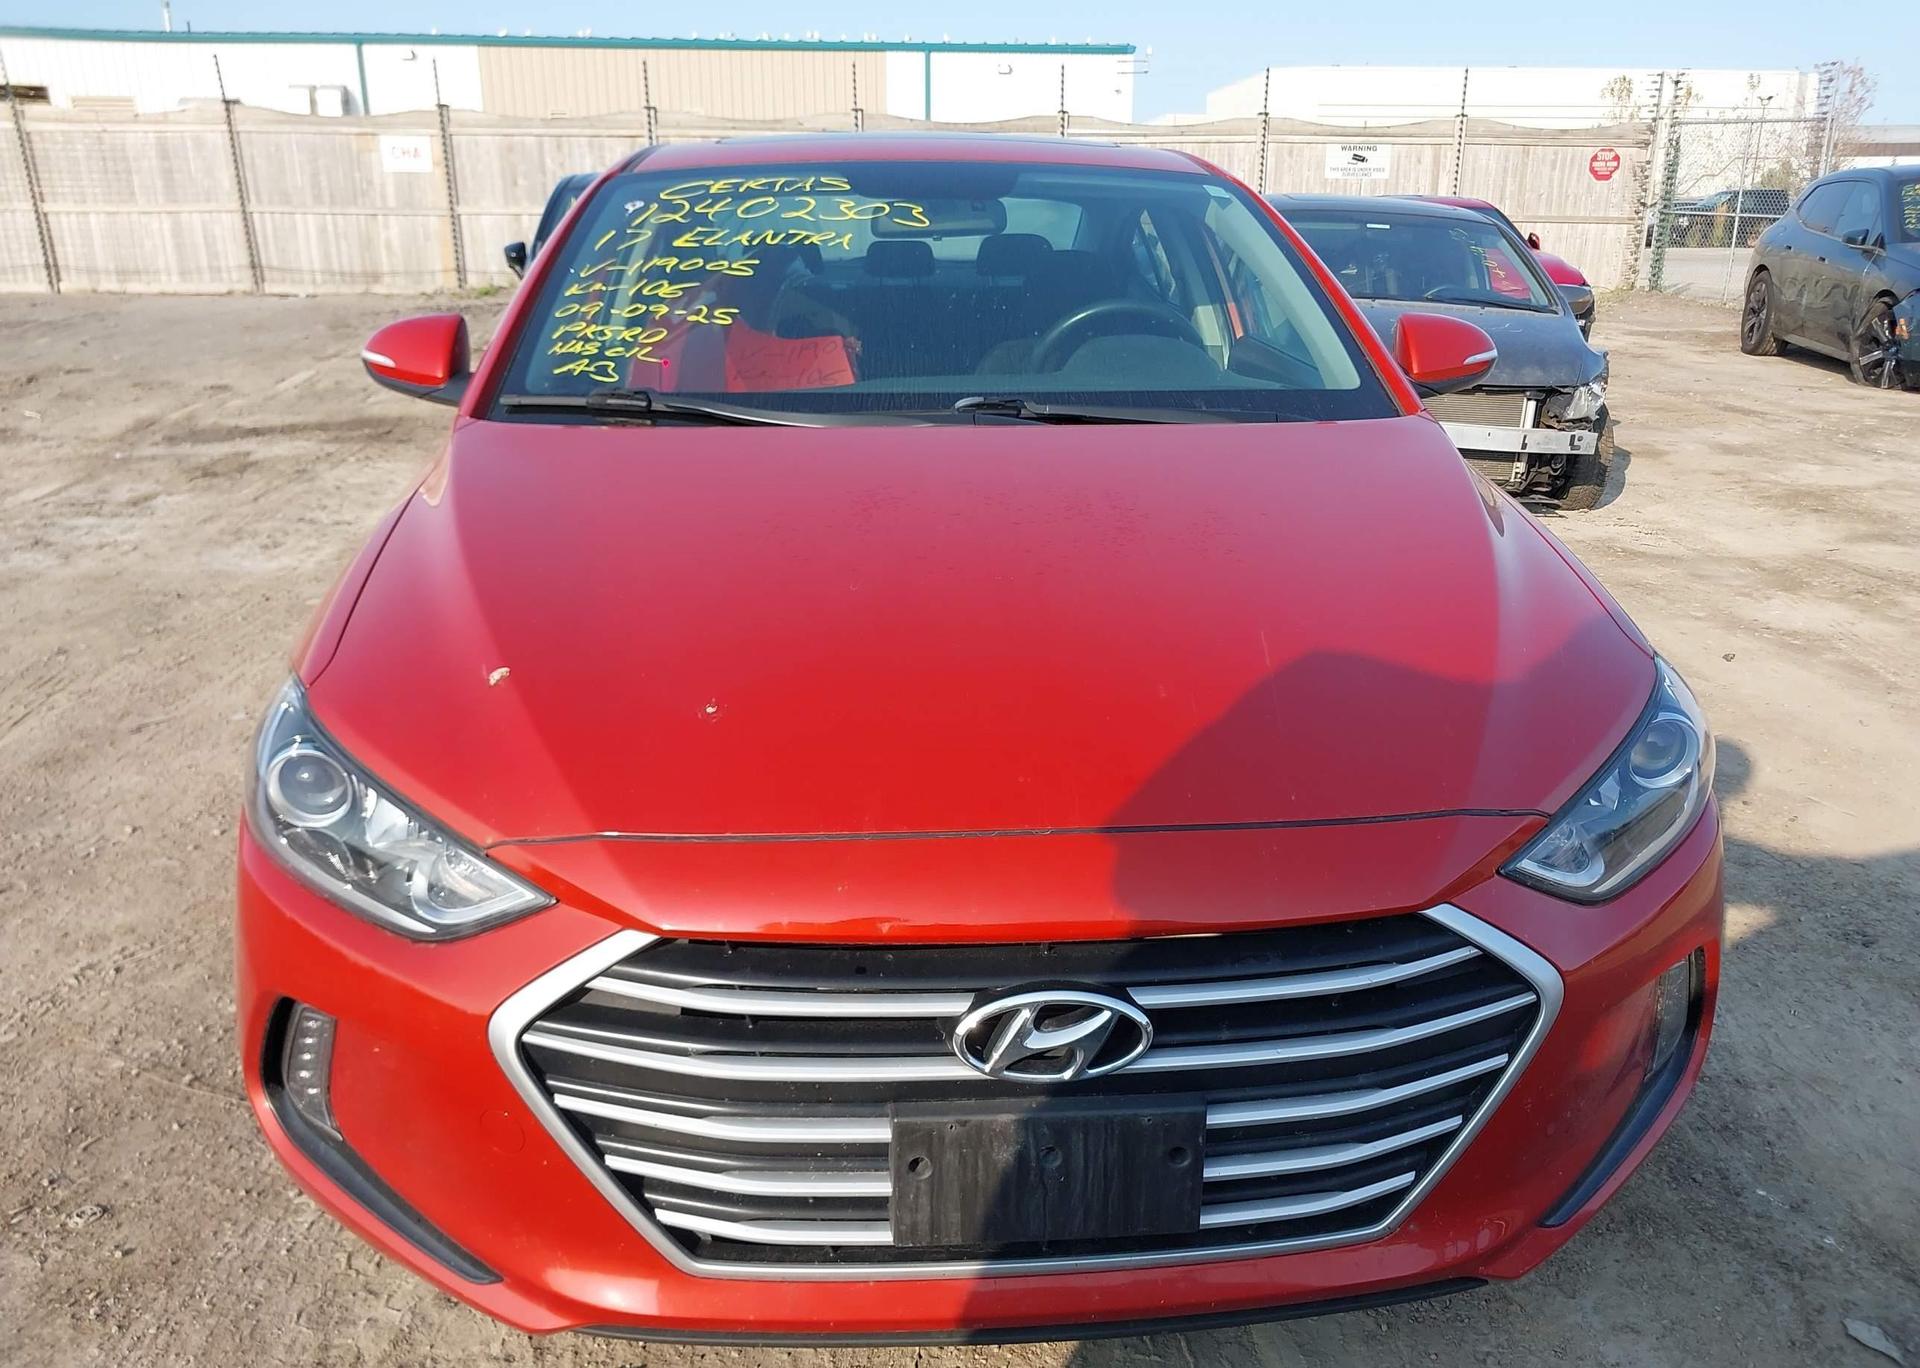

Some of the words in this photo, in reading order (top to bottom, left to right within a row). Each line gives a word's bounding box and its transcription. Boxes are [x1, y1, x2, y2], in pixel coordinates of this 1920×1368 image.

[1597, 151, 1617, 161] STOP
[659, 176, 852, 200] CERTAS
[631, 196, 930, 228] 12402303
[594, 228, 652, 251] 17
[672, 226, 853, 250] ELANTRA
[555, 301, 740, 326] 09-09-25
